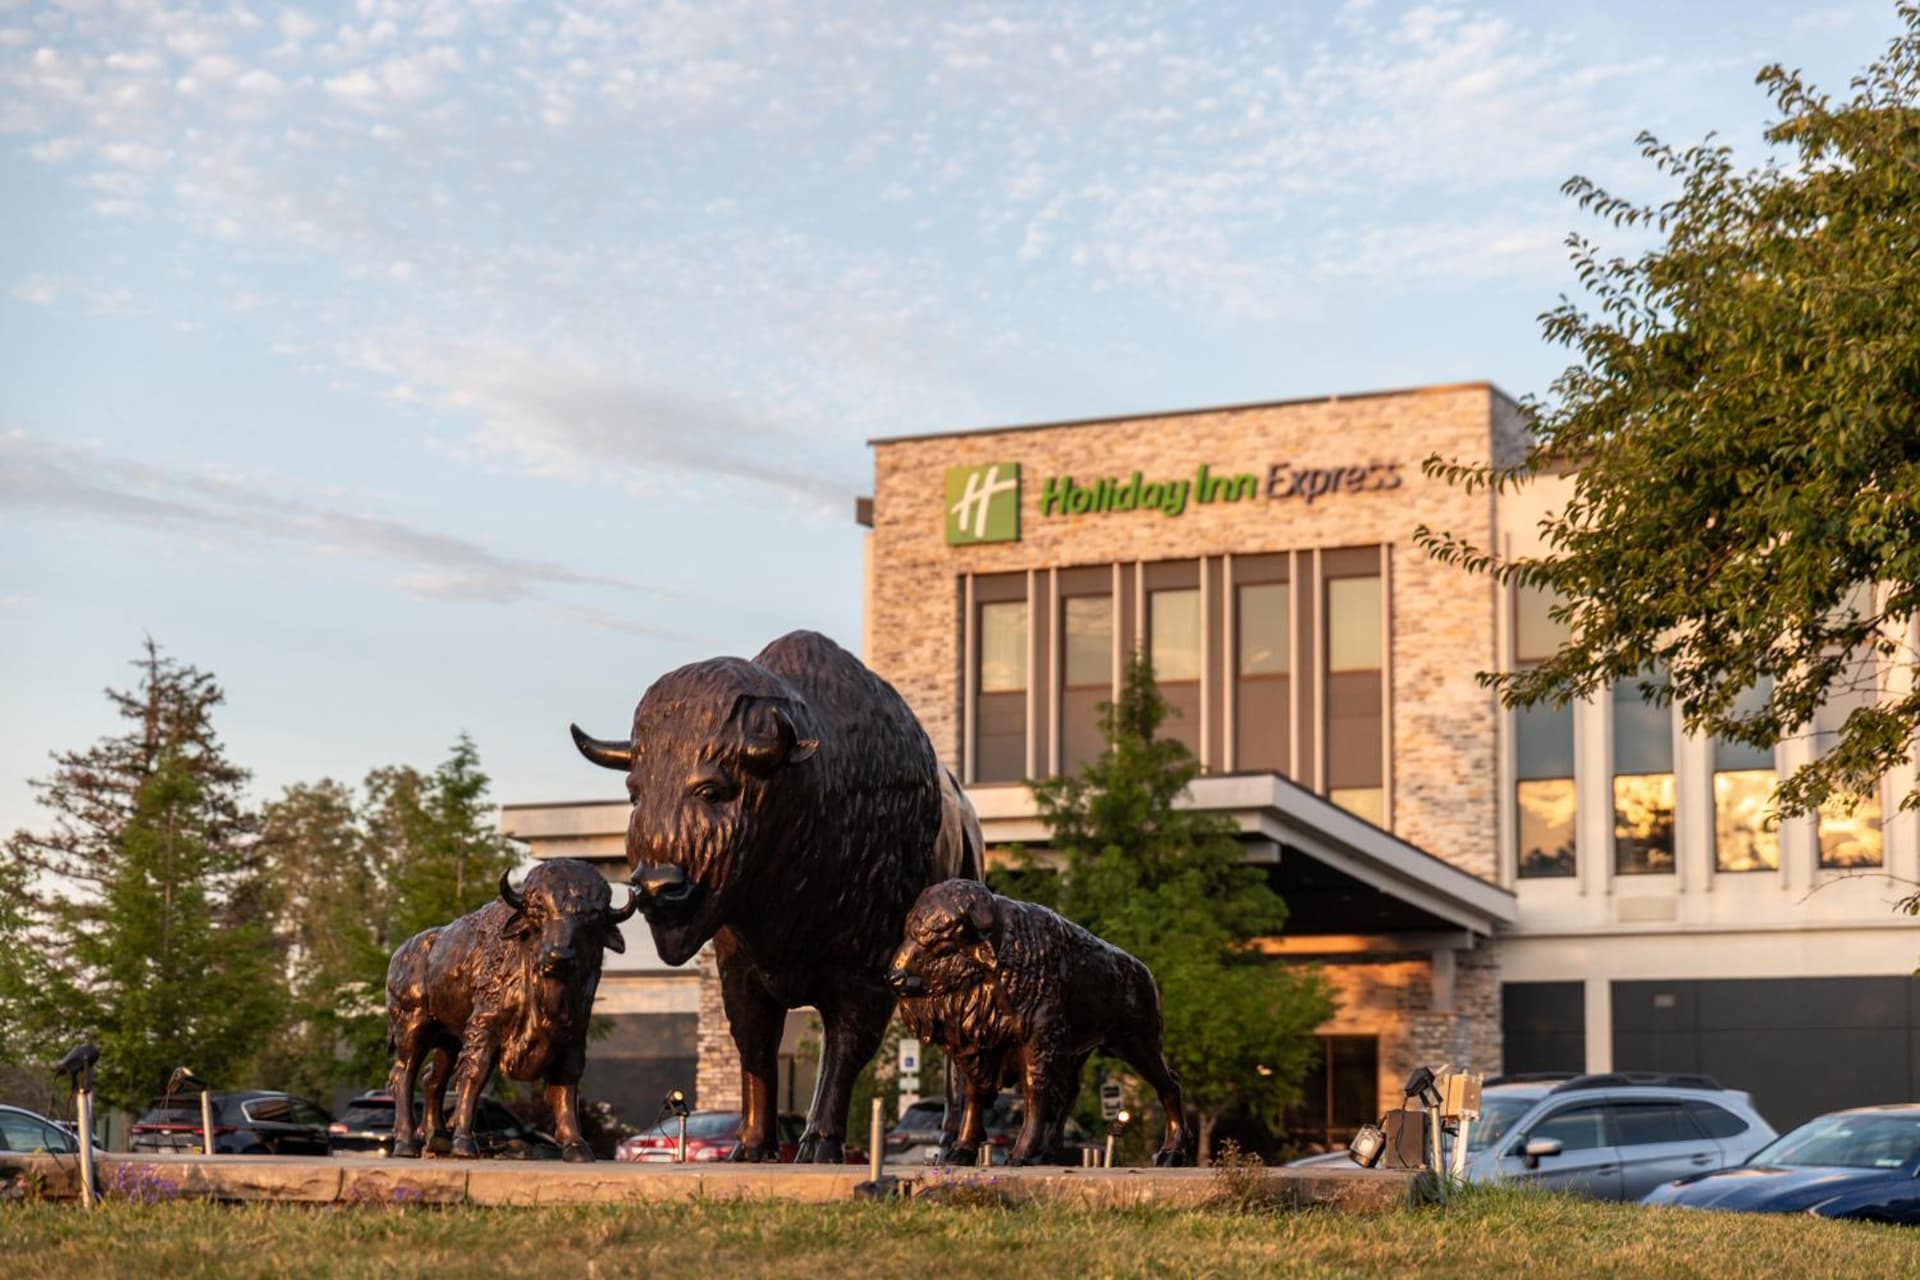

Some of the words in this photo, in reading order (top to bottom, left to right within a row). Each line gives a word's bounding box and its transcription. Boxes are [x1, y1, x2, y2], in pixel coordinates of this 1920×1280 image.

[1039, 470, 1190, 517] Holiday
[1194, 463, 1258, 504] Inn
[1265, 459, 1404, 504] Express
